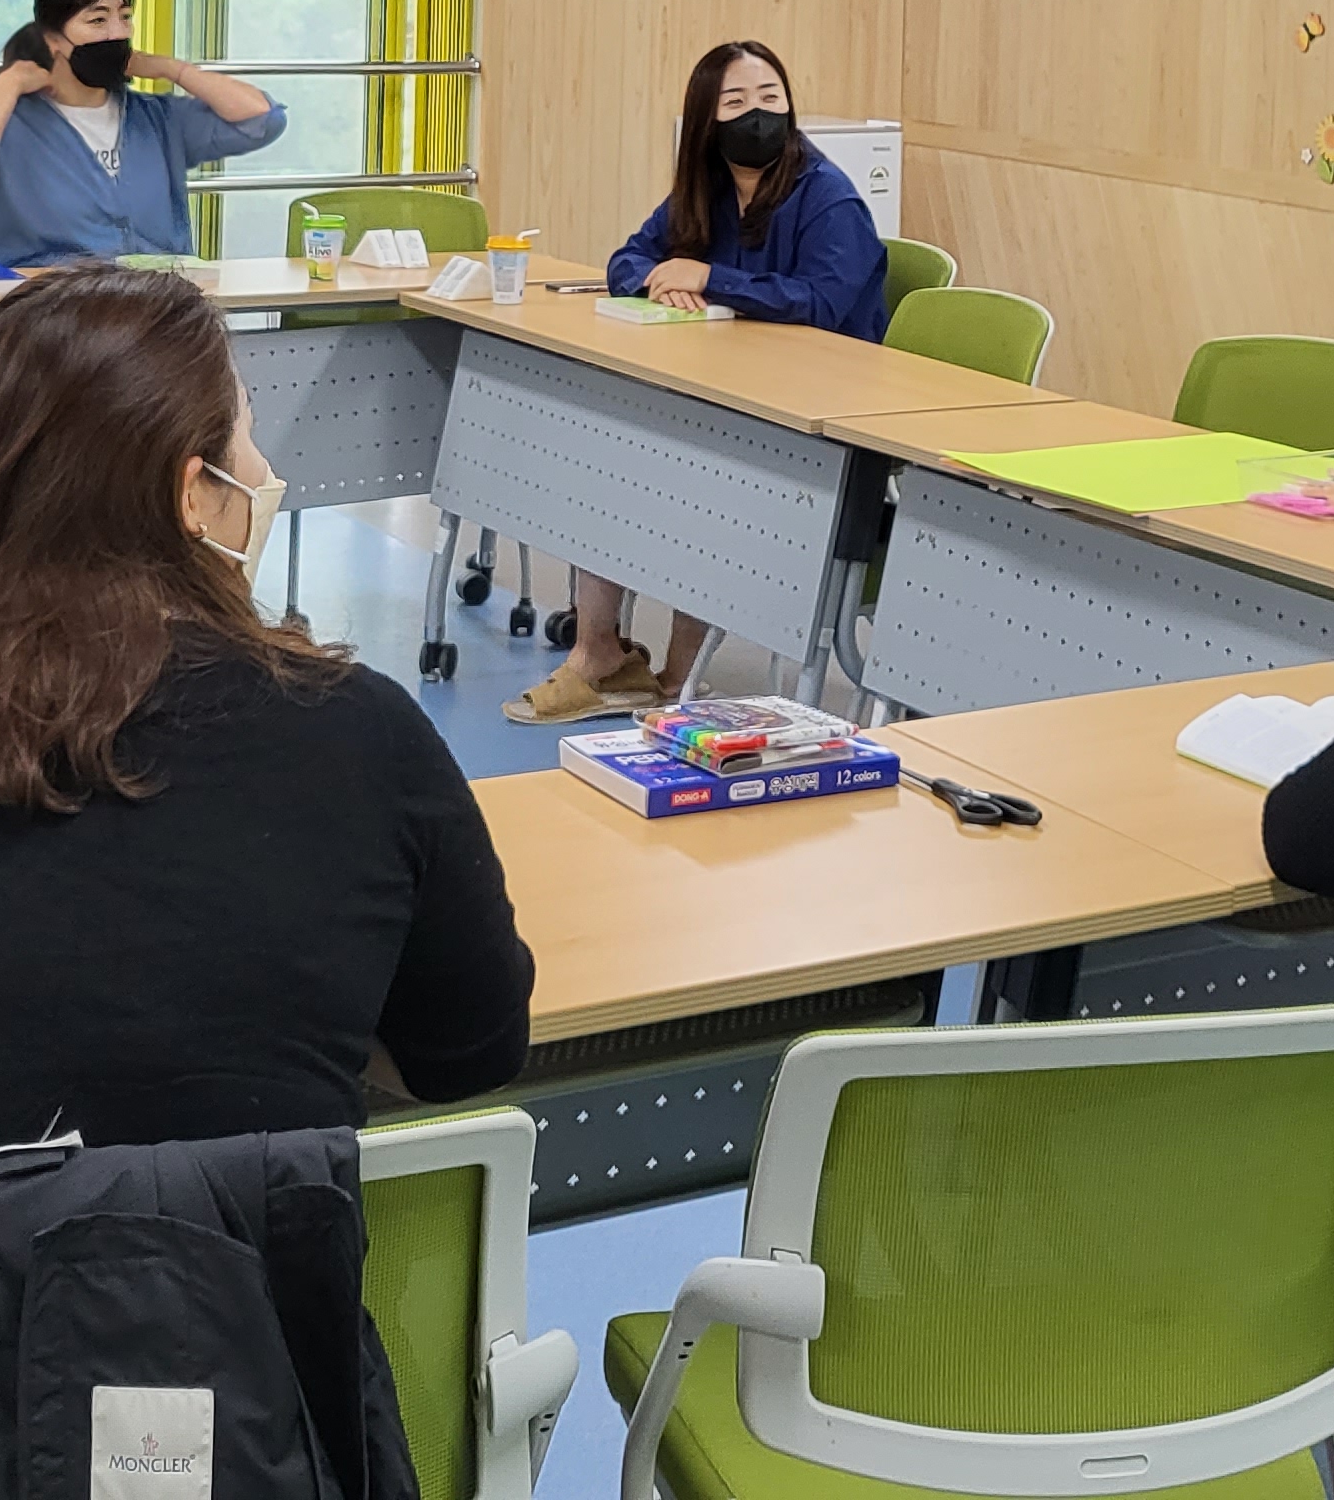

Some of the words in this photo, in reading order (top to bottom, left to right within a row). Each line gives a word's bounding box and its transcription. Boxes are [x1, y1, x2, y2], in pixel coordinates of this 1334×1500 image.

[836, 769, 851, 787] 12
[853, 770, 882, 782] colors
[108, 1454, 193, 1474] MONCLER
